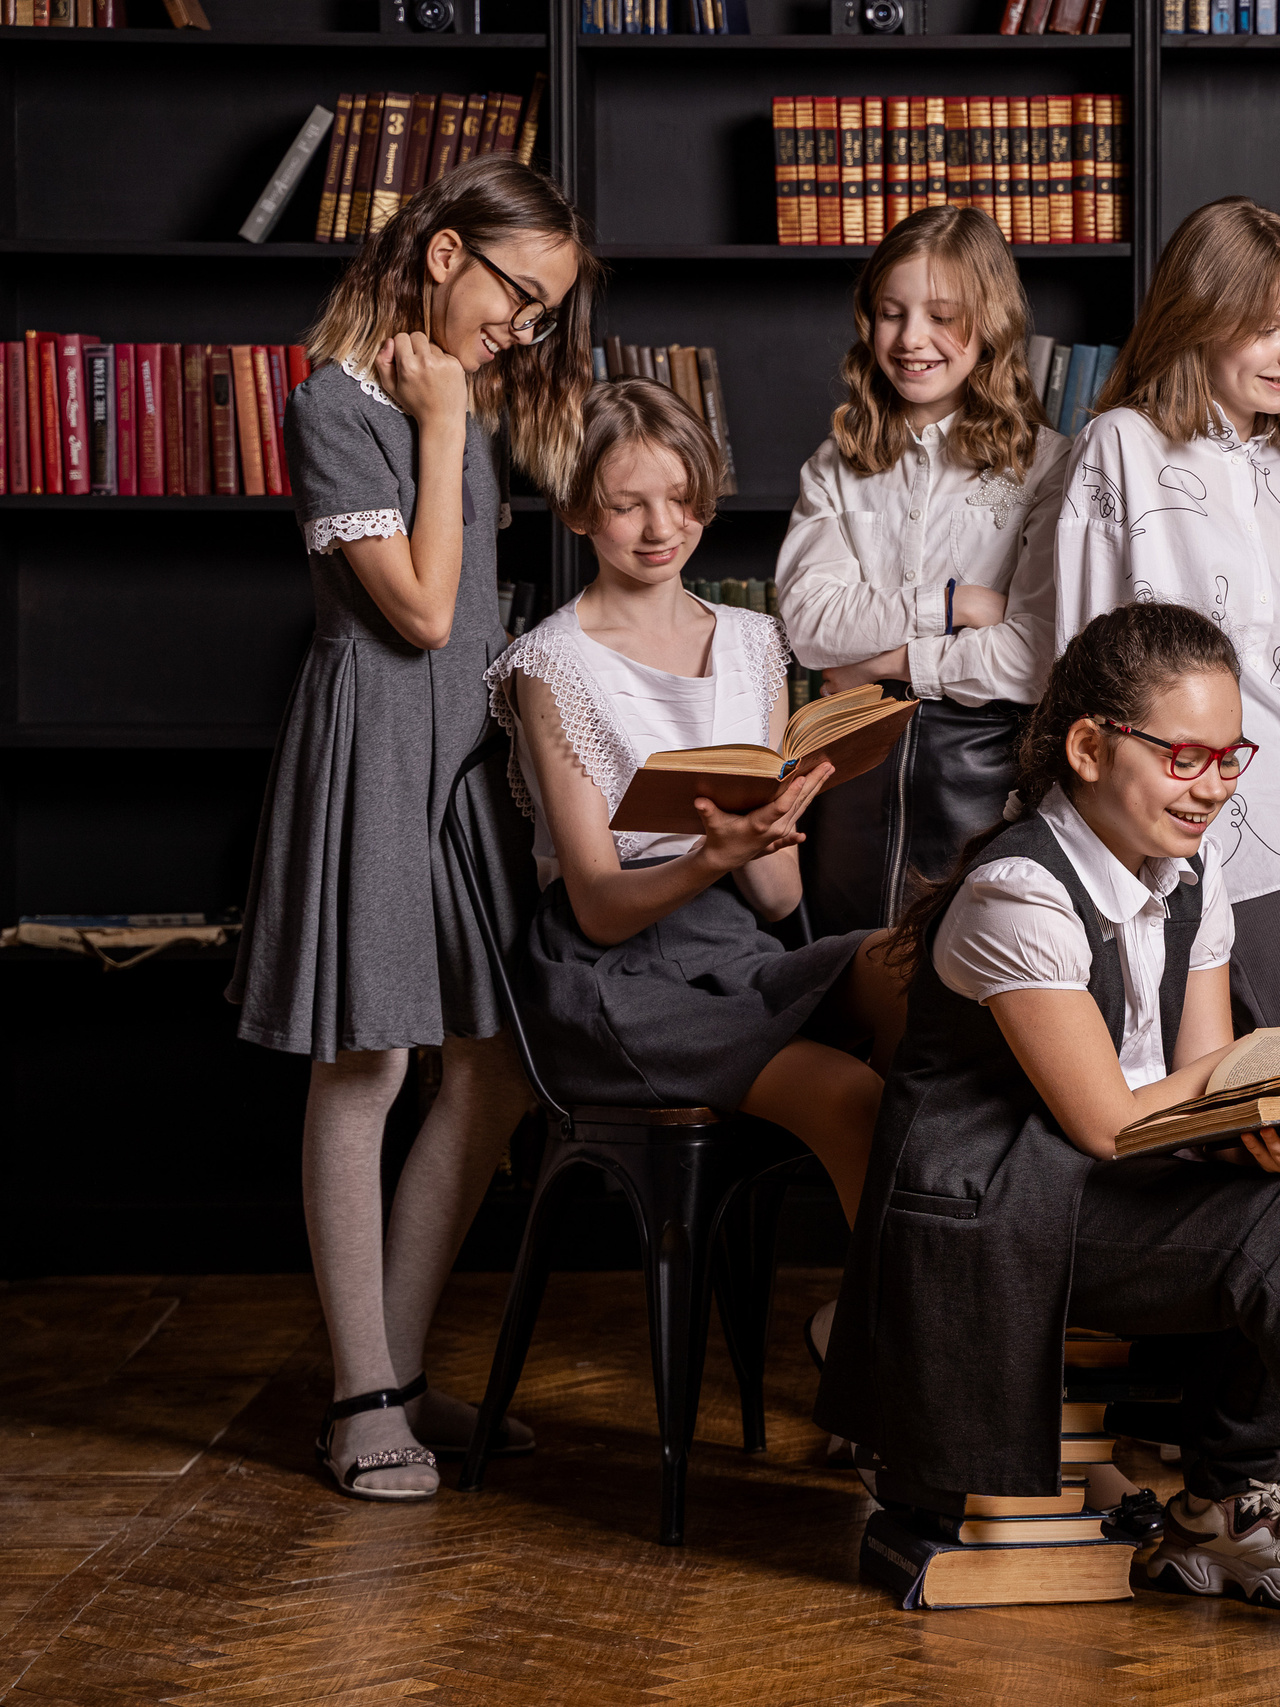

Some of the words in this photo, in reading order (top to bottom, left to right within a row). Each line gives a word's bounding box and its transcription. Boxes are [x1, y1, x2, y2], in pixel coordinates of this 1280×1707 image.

[387, 112, 405, 136] 3
[440, 114, 456, 136] 5
[462, 115, 479, 137] 6
[485, 112, 498, 133] 7
[498, 114, 516, 136] 8
[93, 358, 106, 396] TITAN
[94, 398, 106, 422] THE
